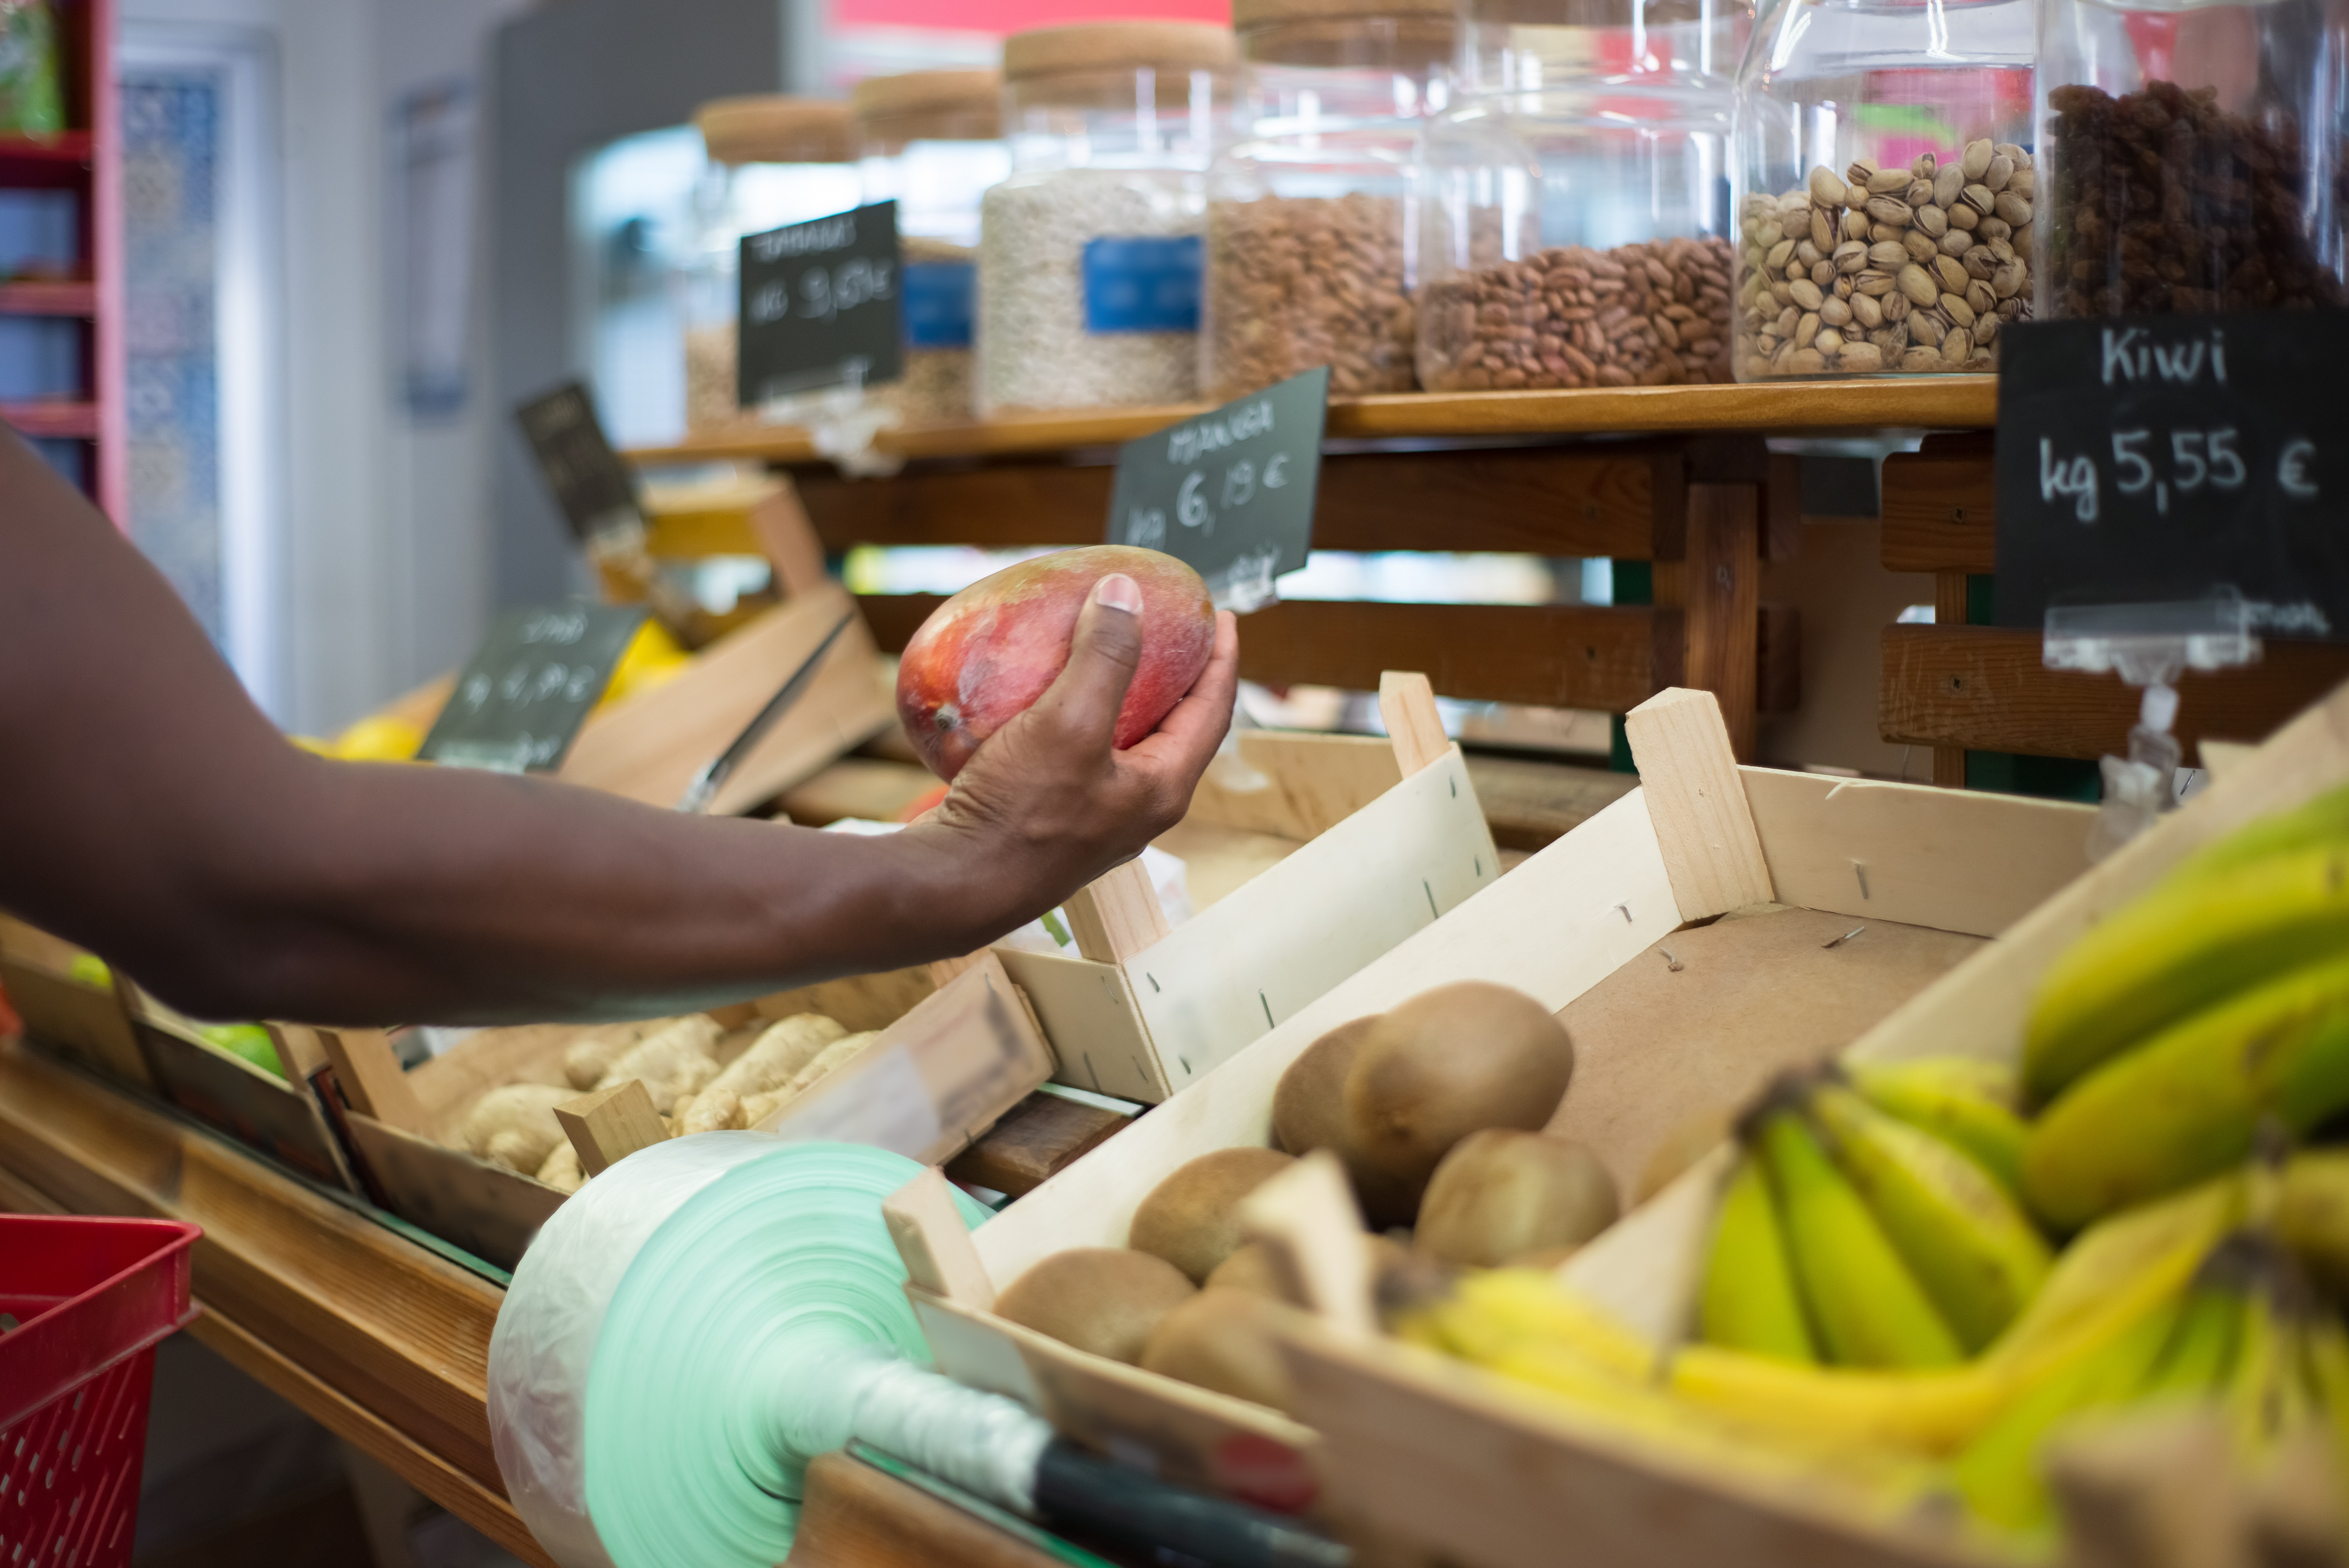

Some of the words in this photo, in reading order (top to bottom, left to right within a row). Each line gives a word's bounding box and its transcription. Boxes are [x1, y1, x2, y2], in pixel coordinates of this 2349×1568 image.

[2101, 327, 2227, 385] Kiwi
[2039, 437, 2099, 524] kg
[2112, 428, 2247, 515] 5,55
[2277, 440, 2320, 496] €
